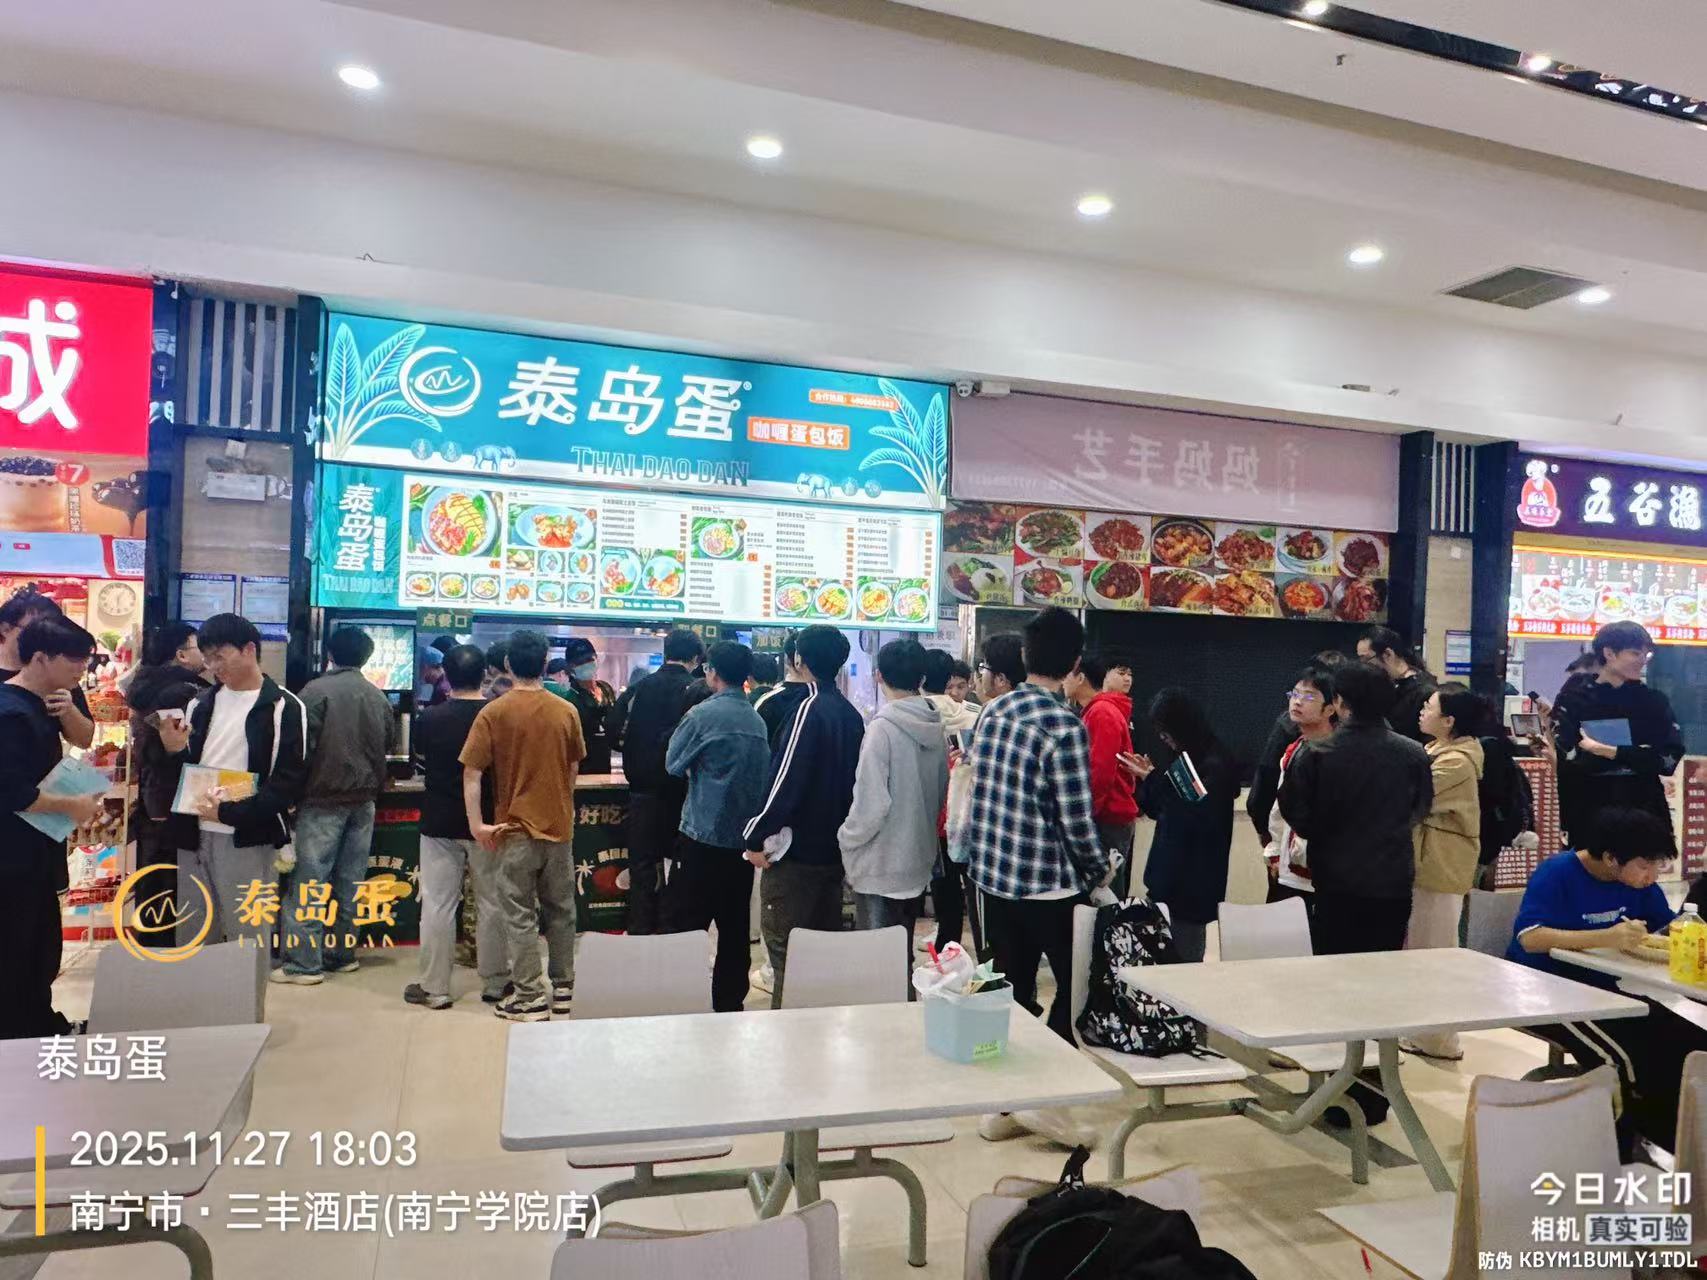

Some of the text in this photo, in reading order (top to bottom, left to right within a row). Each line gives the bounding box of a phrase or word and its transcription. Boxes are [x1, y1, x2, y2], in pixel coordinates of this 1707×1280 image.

[497, 355, 743, 443] 泰岛蛋
[751, 420, 844, 448] 咖喱蛋包饭
[570, 446, 751, 488] THAI DAO DAN
[333, 482, 375, 572] 泰岛蛋
